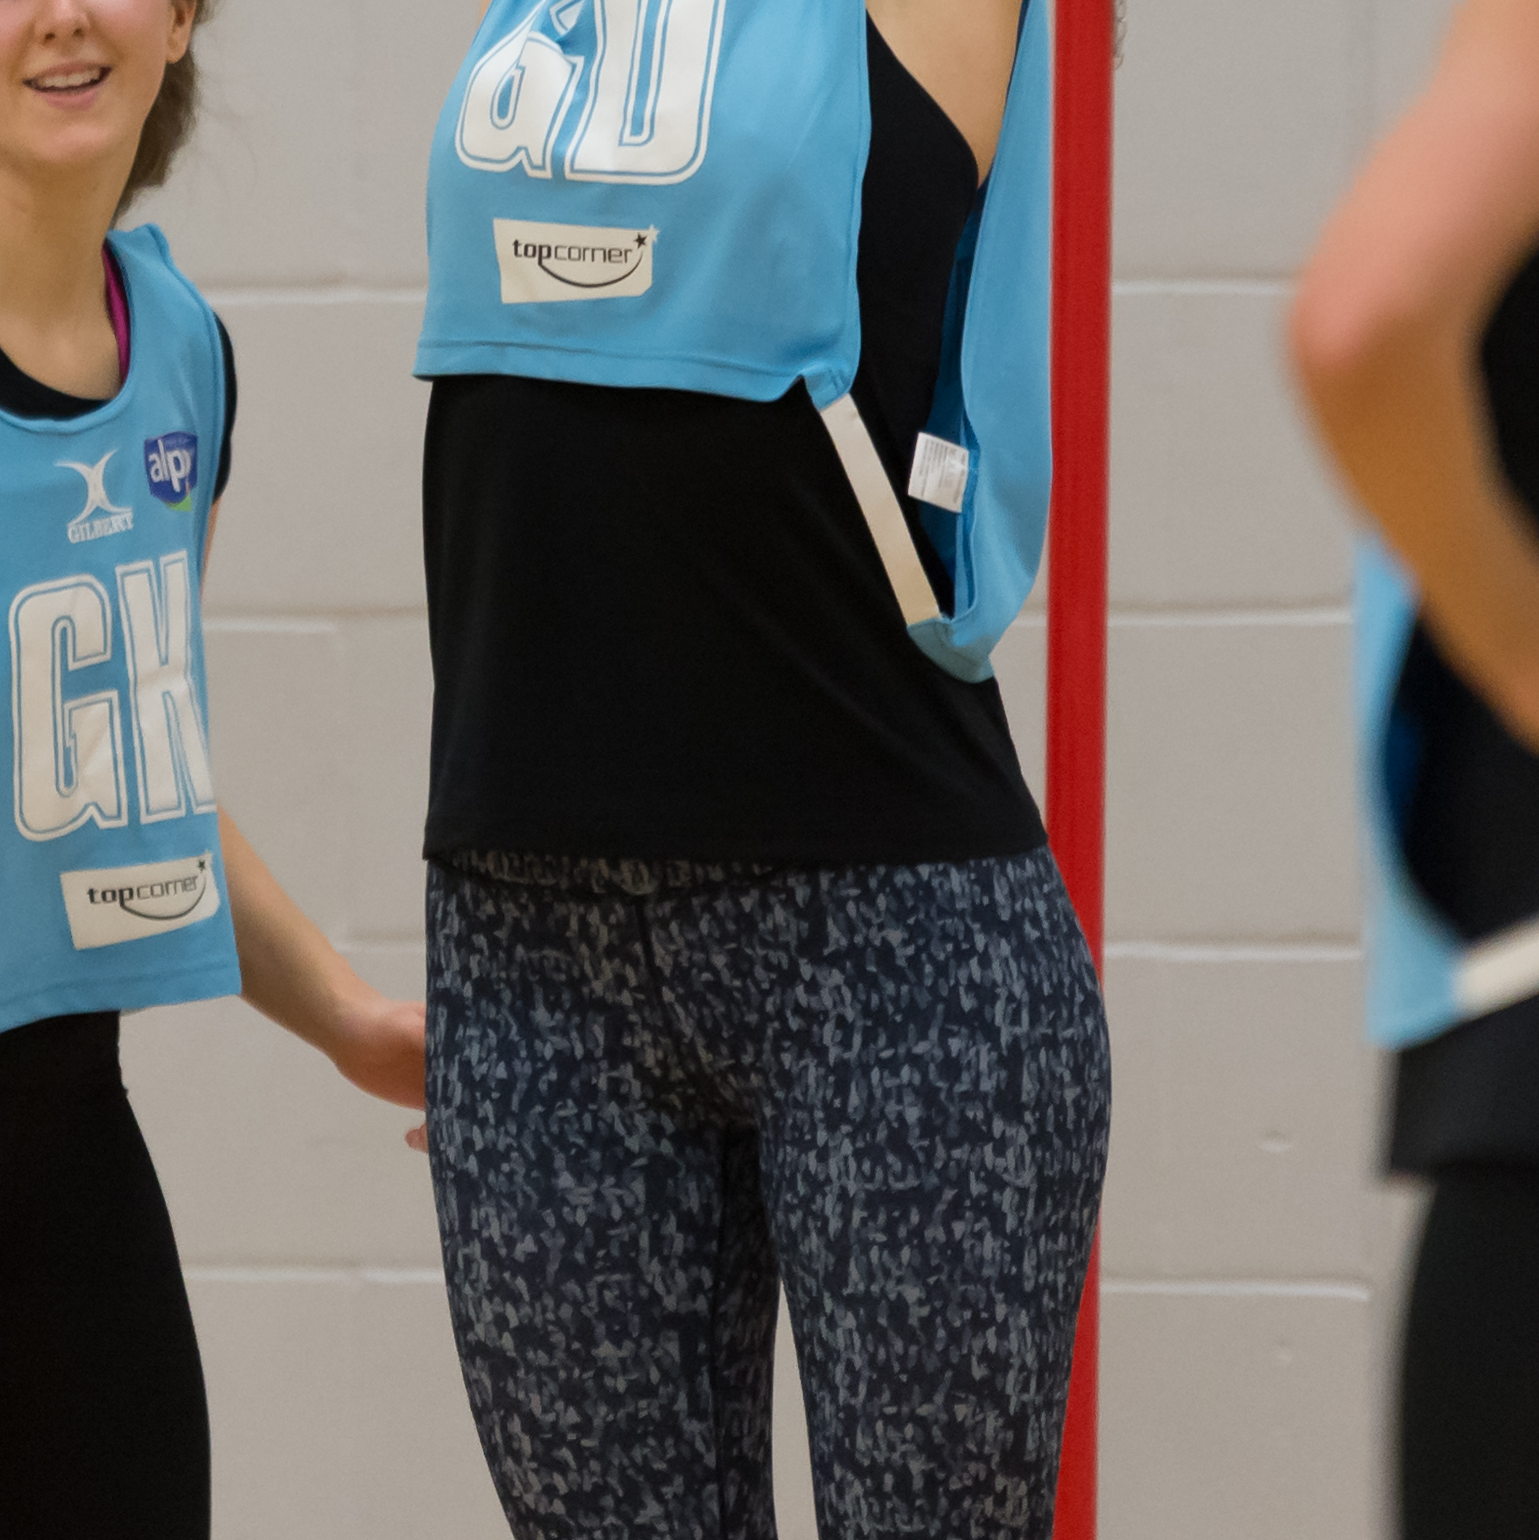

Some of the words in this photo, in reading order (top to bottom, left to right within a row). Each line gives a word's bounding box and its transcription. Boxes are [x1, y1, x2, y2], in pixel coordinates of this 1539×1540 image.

[512, 239, 633, 266] topcorner
[9, 550, 216, 842] GK
[87, 875, 199, 908] topcorner
